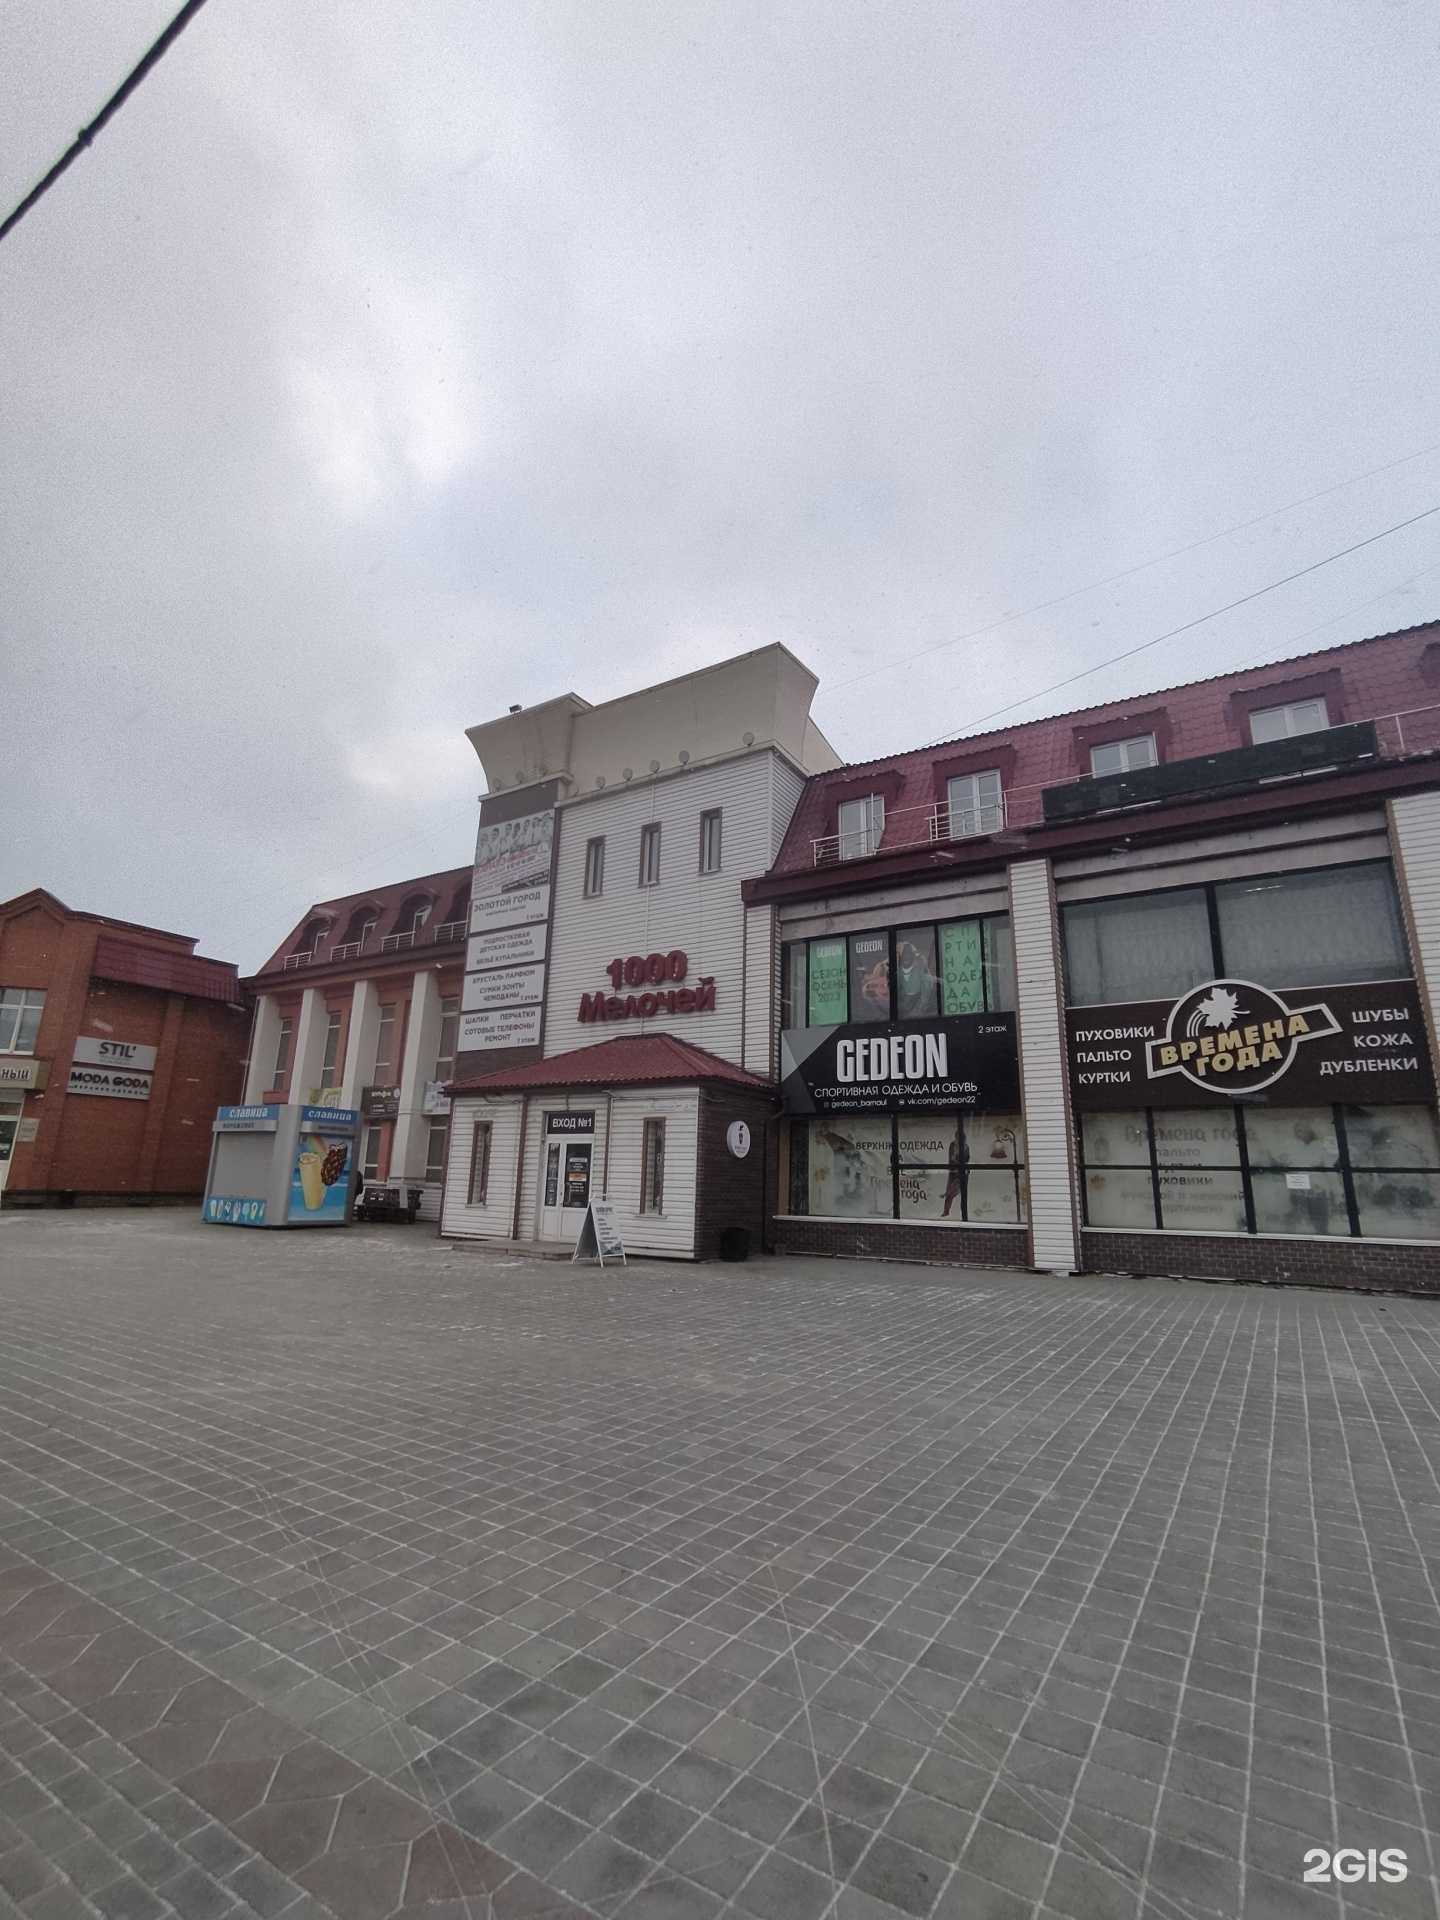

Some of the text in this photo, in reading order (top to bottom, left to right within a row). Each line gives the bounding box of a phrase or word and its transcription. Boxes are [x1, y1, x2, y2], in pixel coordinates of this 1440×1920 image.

[474, 896, 511, 912] ЗОЛОТОЙ
[512, 891, 541, 904] ГОРОД
[855, 940, 883, 953] GEDEON
[606, 950, 688, 991] 1000
[502, 982, 525, 992] ЗОНТЫ
[577, 976, 717, 1023] Мелочей
[465, 1011, 536, 1025] ШАПКИ ПЕРЧАТКИ
[1352, 1008, 1409, 1023] ШУБЫ
[464, 1022, 535, 1036] СОТОВЫЕ ТЕЛЕФОНЫ
[978, 1025, 1007, 1034] 2 этаж
[1075, 1026, 1155, 1042] ПУХОВИКИ
[484, 1033, 511, 1042] РЕМОНТ
[1160, 1014, 1310, 1066] ВРЕМЕНА
[1354, 1033, 1413, 1048] КОЖА
[836, 1033, 948, 1083] GEDEON
[1076, 1050, 1132, 1063] ПАЛЬТО
[1196, 1041, 1283, 1076] ГОДА
[1319, 1057, 1418, 1076] ДУБЛЕНКИ
[70, 1071, 149, 1089] MODA GODA
[1078, 1072, 1131, 1084] КУРТКИ
[814, 1082, 978, 1098] СПОРТИВНАЯ ОДЕЖДА И ОБУВЬ
[907, 1096, 976, 1105] vk.com/gedeon22
[552, 1117, 592, 1129] ВХОД №1
[900, 1141, 945, 1152] ОДЕЖДА
